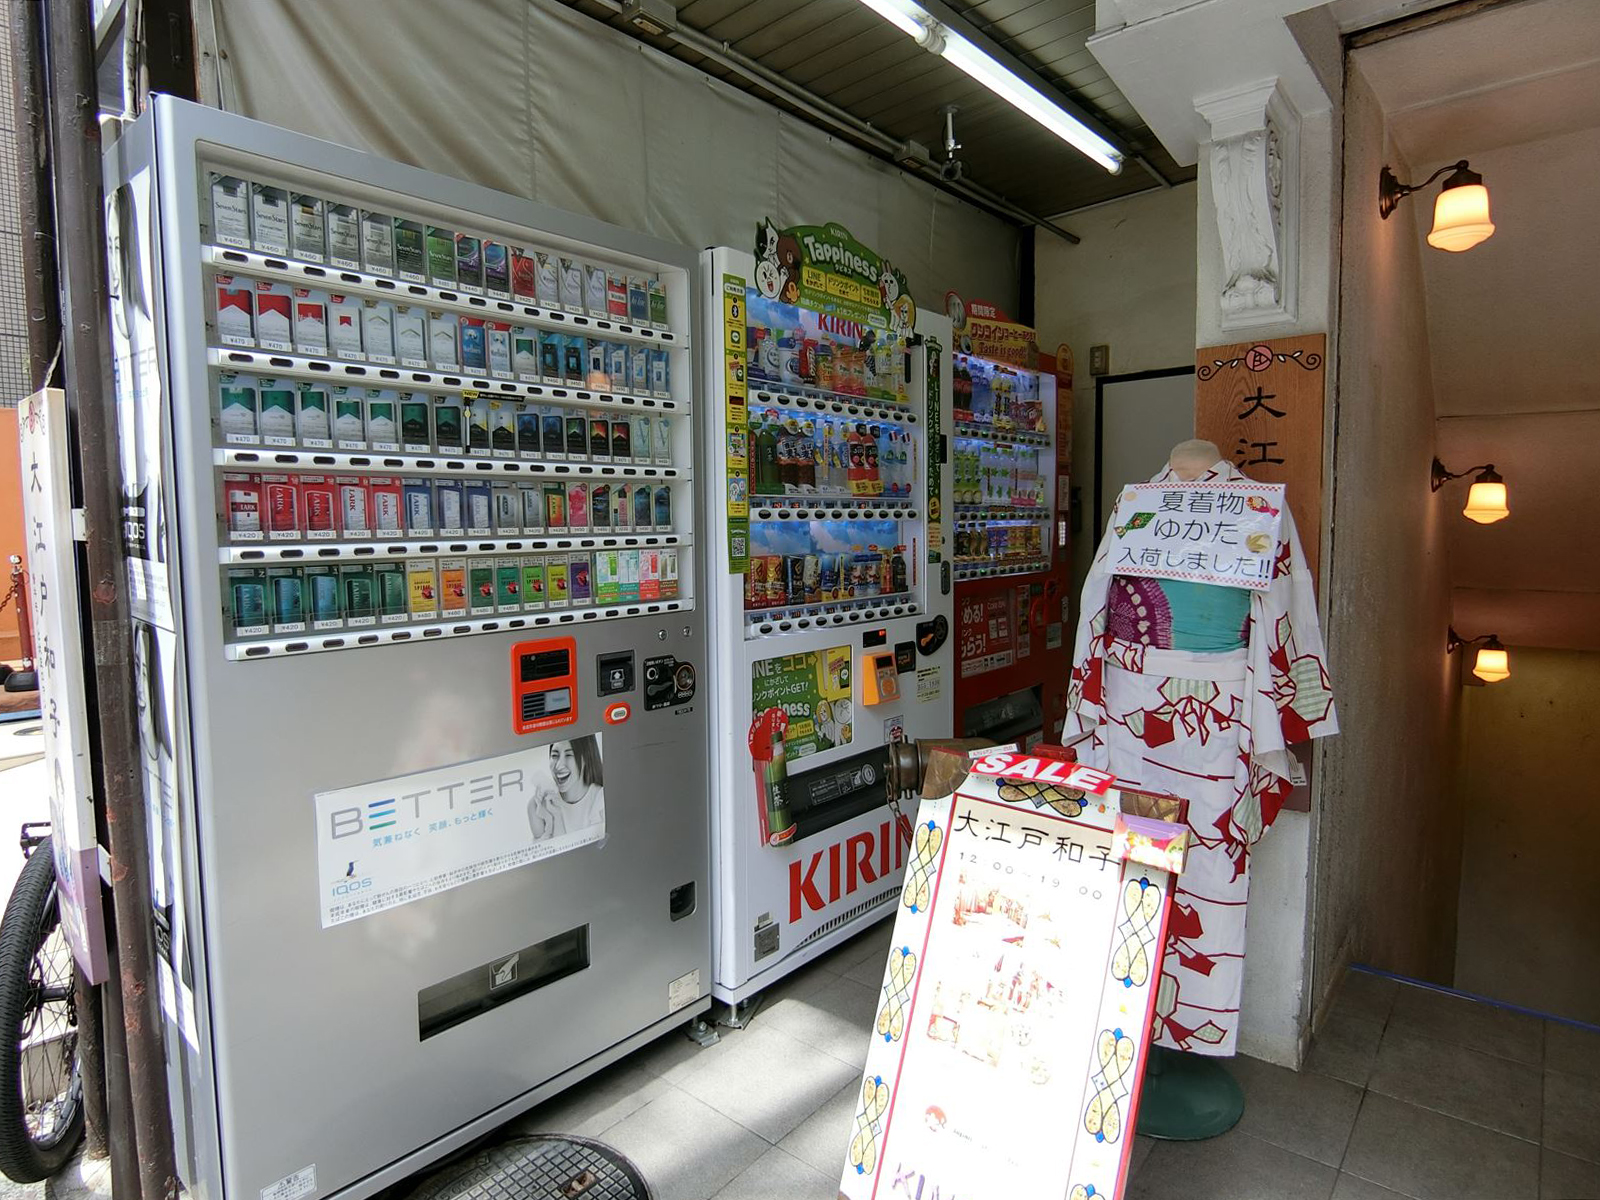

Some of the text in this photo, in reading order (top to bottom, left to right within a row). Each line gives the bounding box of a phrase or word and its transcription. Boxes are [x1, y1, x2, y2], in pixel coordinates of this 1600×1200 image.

[803, 234, 878, 282] Tappiness
[818, 312, 863, 341] KIRIN
[276, 487, 284, 511] LARK
[1158, 490, 1245, 515] 夏着物
[1154, 518, 1239, 546] ゆかた
[1117, 547, 1272, 580] 入荷しました!!
[961, 603, 984, 624] める!
[976, 753, 1112, 791] SALE
[330, 768, 524, 840] BETTER
[372, 827, 421, 848] 気兼ねなく
[954, 809, 1121, 872] 大江戸和子
[331, 877, 374, 897] IQOS
